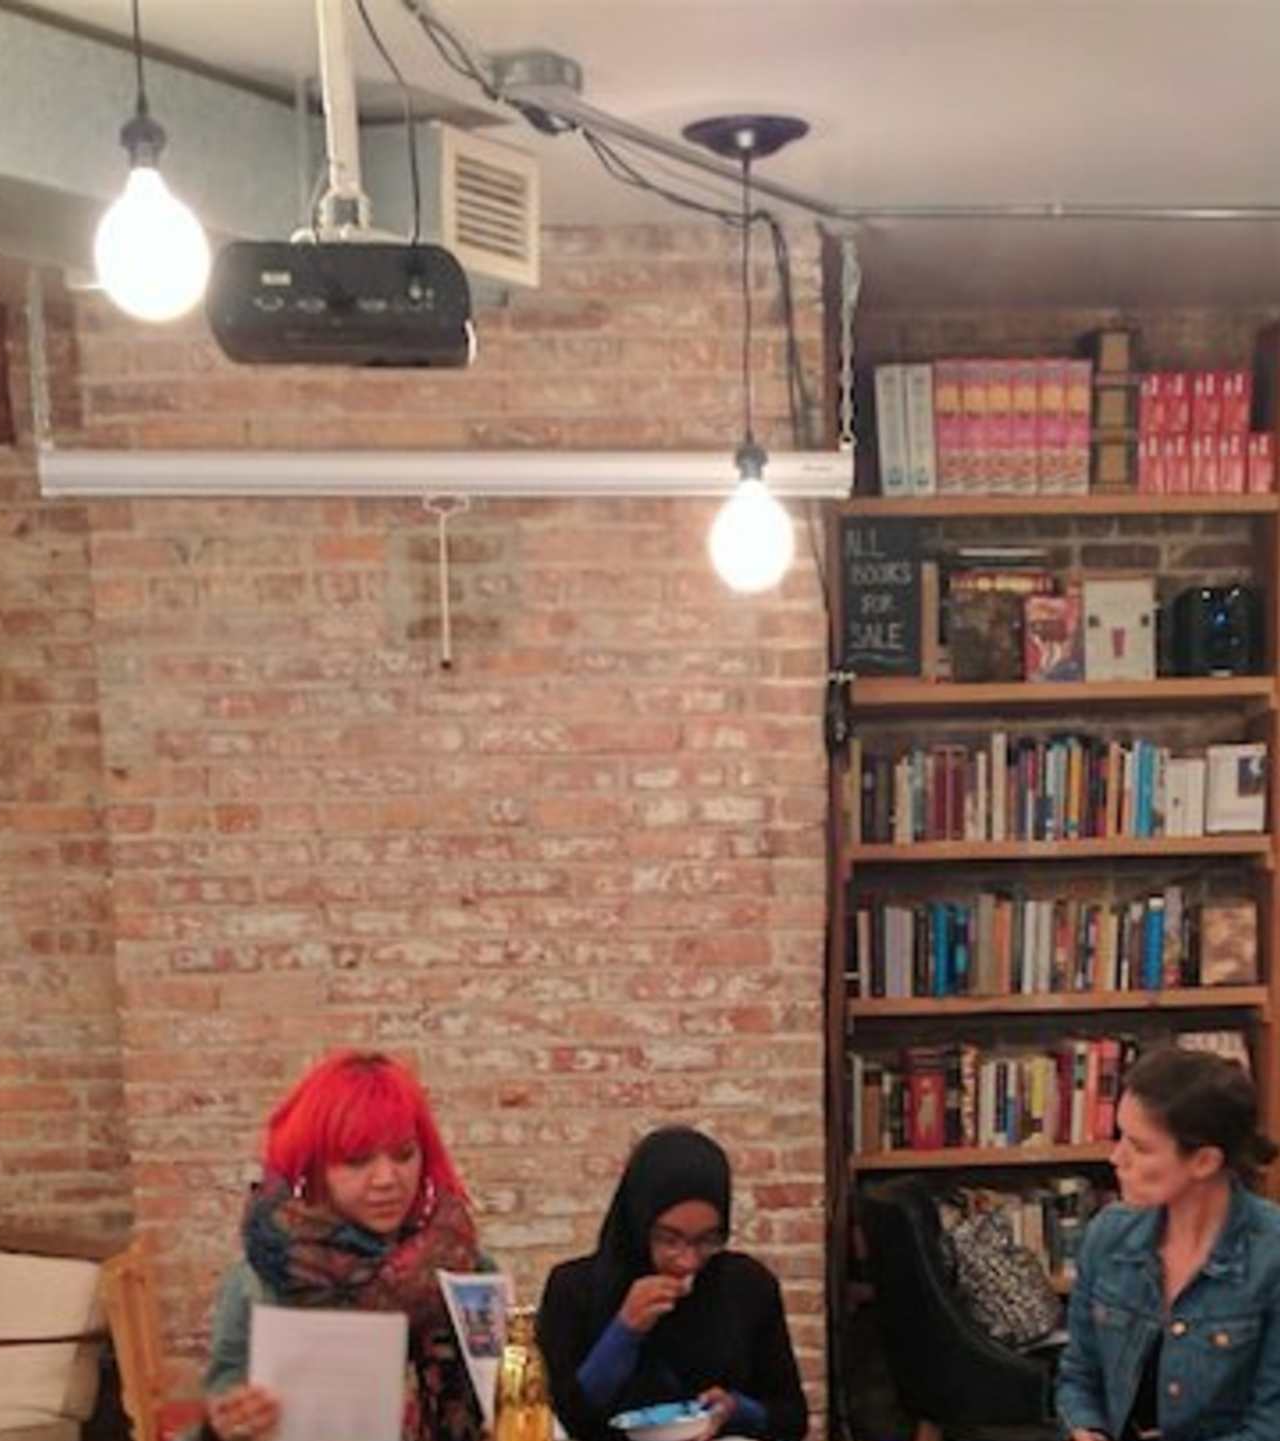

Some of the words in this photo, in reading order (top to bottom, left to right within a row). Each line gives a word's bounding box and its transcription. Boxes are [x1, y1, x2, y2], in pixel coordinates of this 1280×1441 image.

[847, 528, 887, 558] ALL
[850, 563, 913, 586] BOOKS
[849, 621, 905, 650] SALE
